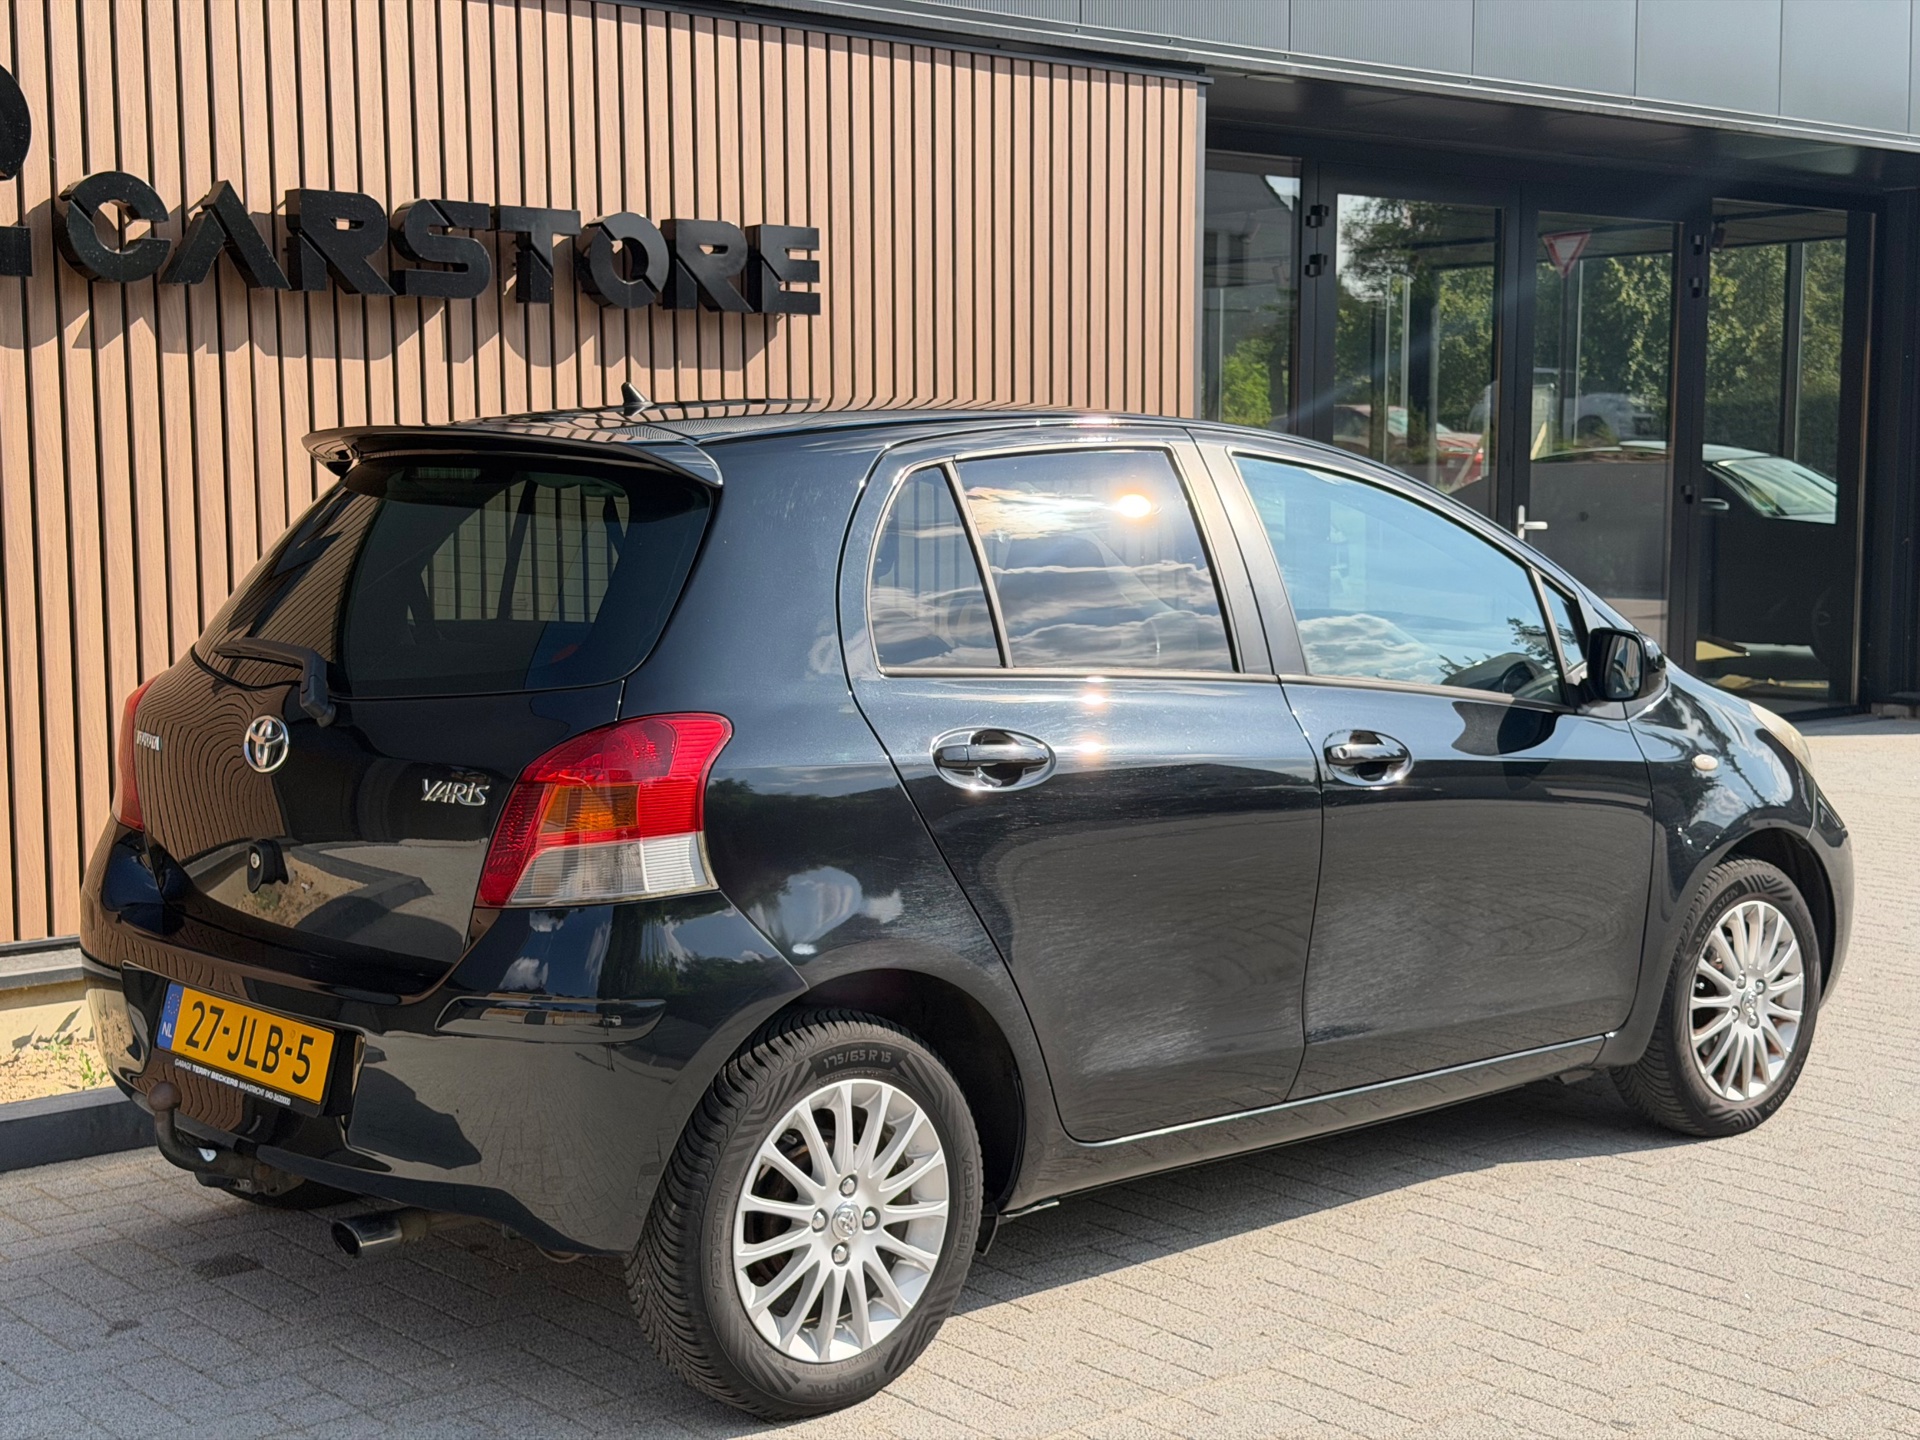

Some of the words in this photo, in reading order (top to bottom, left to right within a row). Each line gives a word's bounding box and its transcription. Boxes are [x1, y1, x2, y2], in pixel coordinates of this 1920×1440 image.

[56, 170, 821, 316] CARSTORE
[421, 778, 490, 806] YARIS
[161, 1021, 173, 1039] NL
[185, 1000, 315, 1085] 27-JLB-5
[823, 1049, 866, 1069] 175/65
[868, 1049, 878, 1062] R
[881, 1050, 892, 1063] 15
